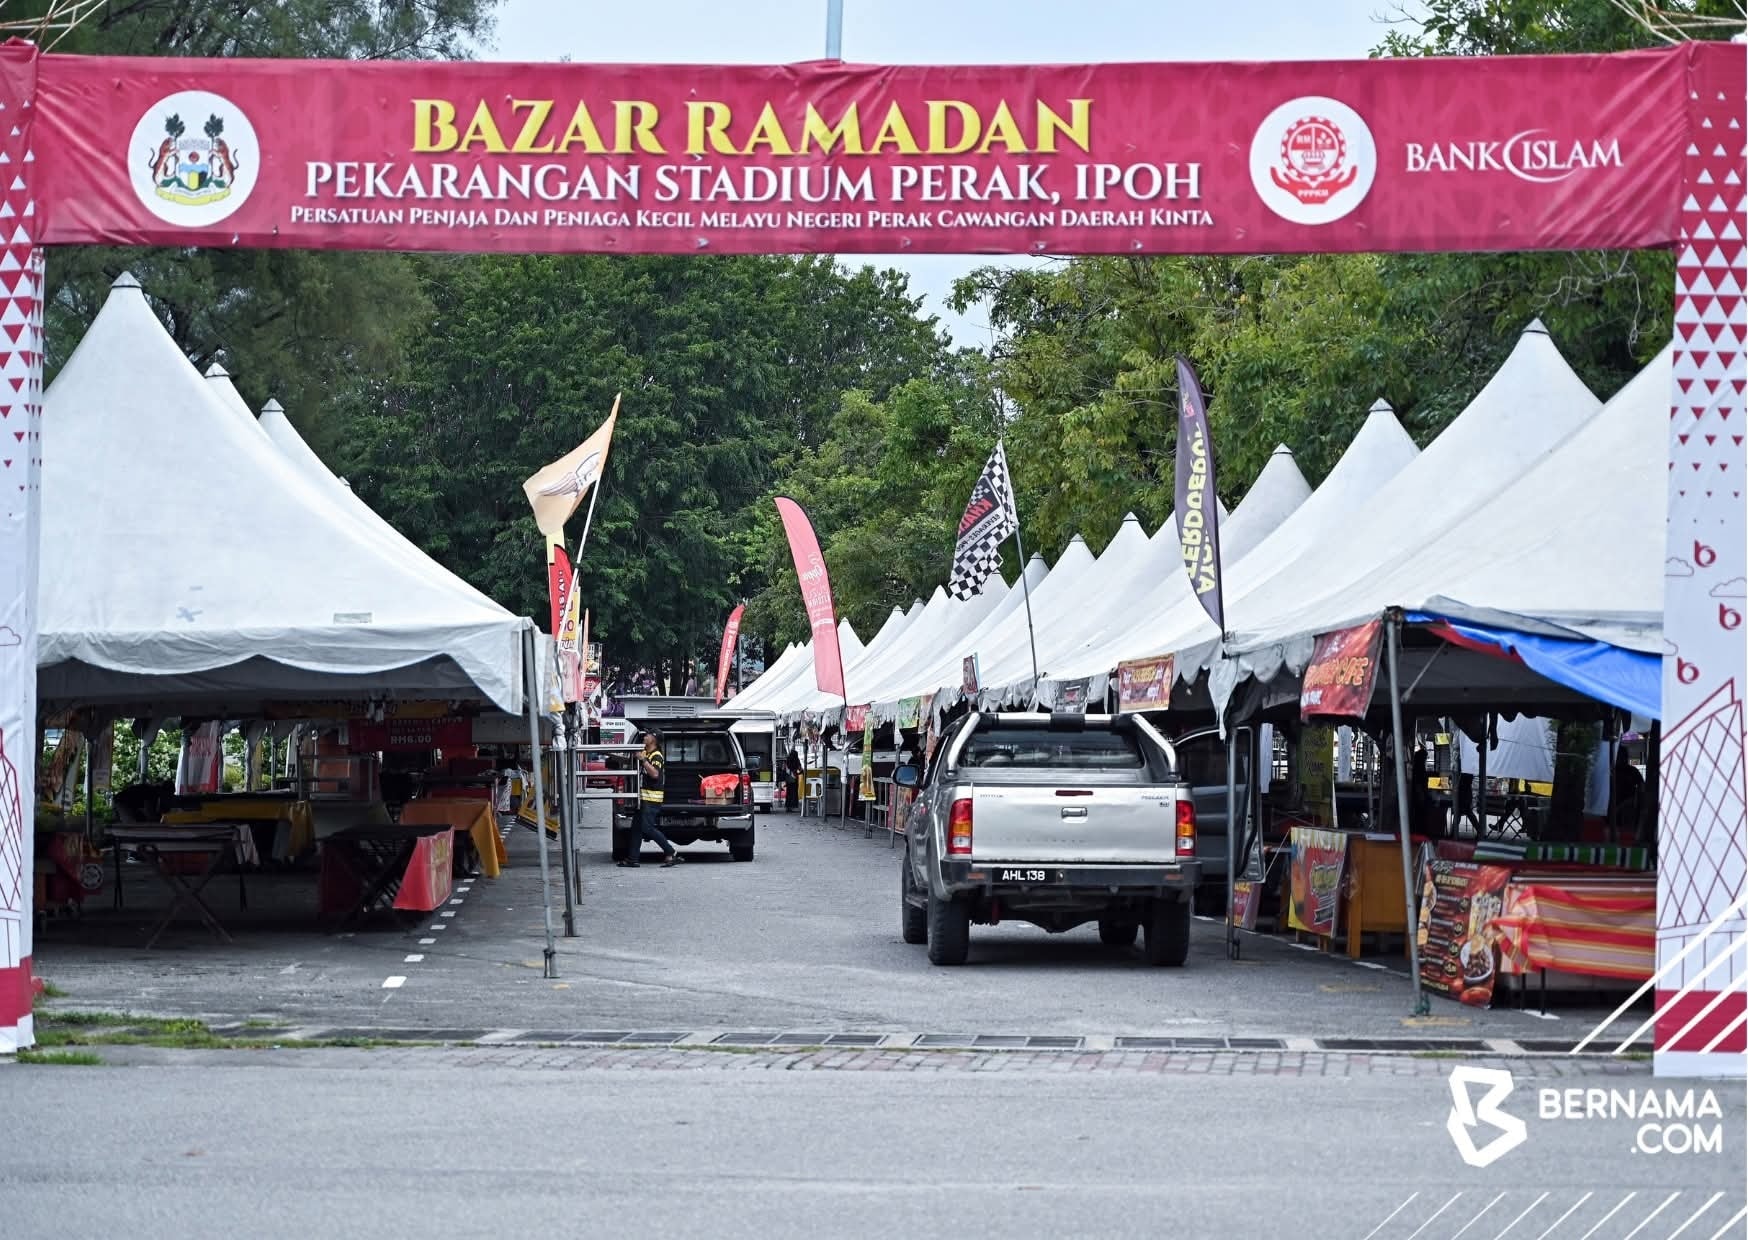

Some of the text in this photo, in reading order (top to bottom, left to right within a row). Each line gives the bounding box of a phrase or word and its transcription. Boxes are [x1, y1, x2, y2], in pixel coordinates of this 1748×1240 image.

[411, 98, 1093, 156] BAZAR RAMADAN
[1406, 138, 1624, 172] BANK ISLAM
[304, 161, 1201, 205] PEKARANGAN STADIUM PERAK, IPOH
